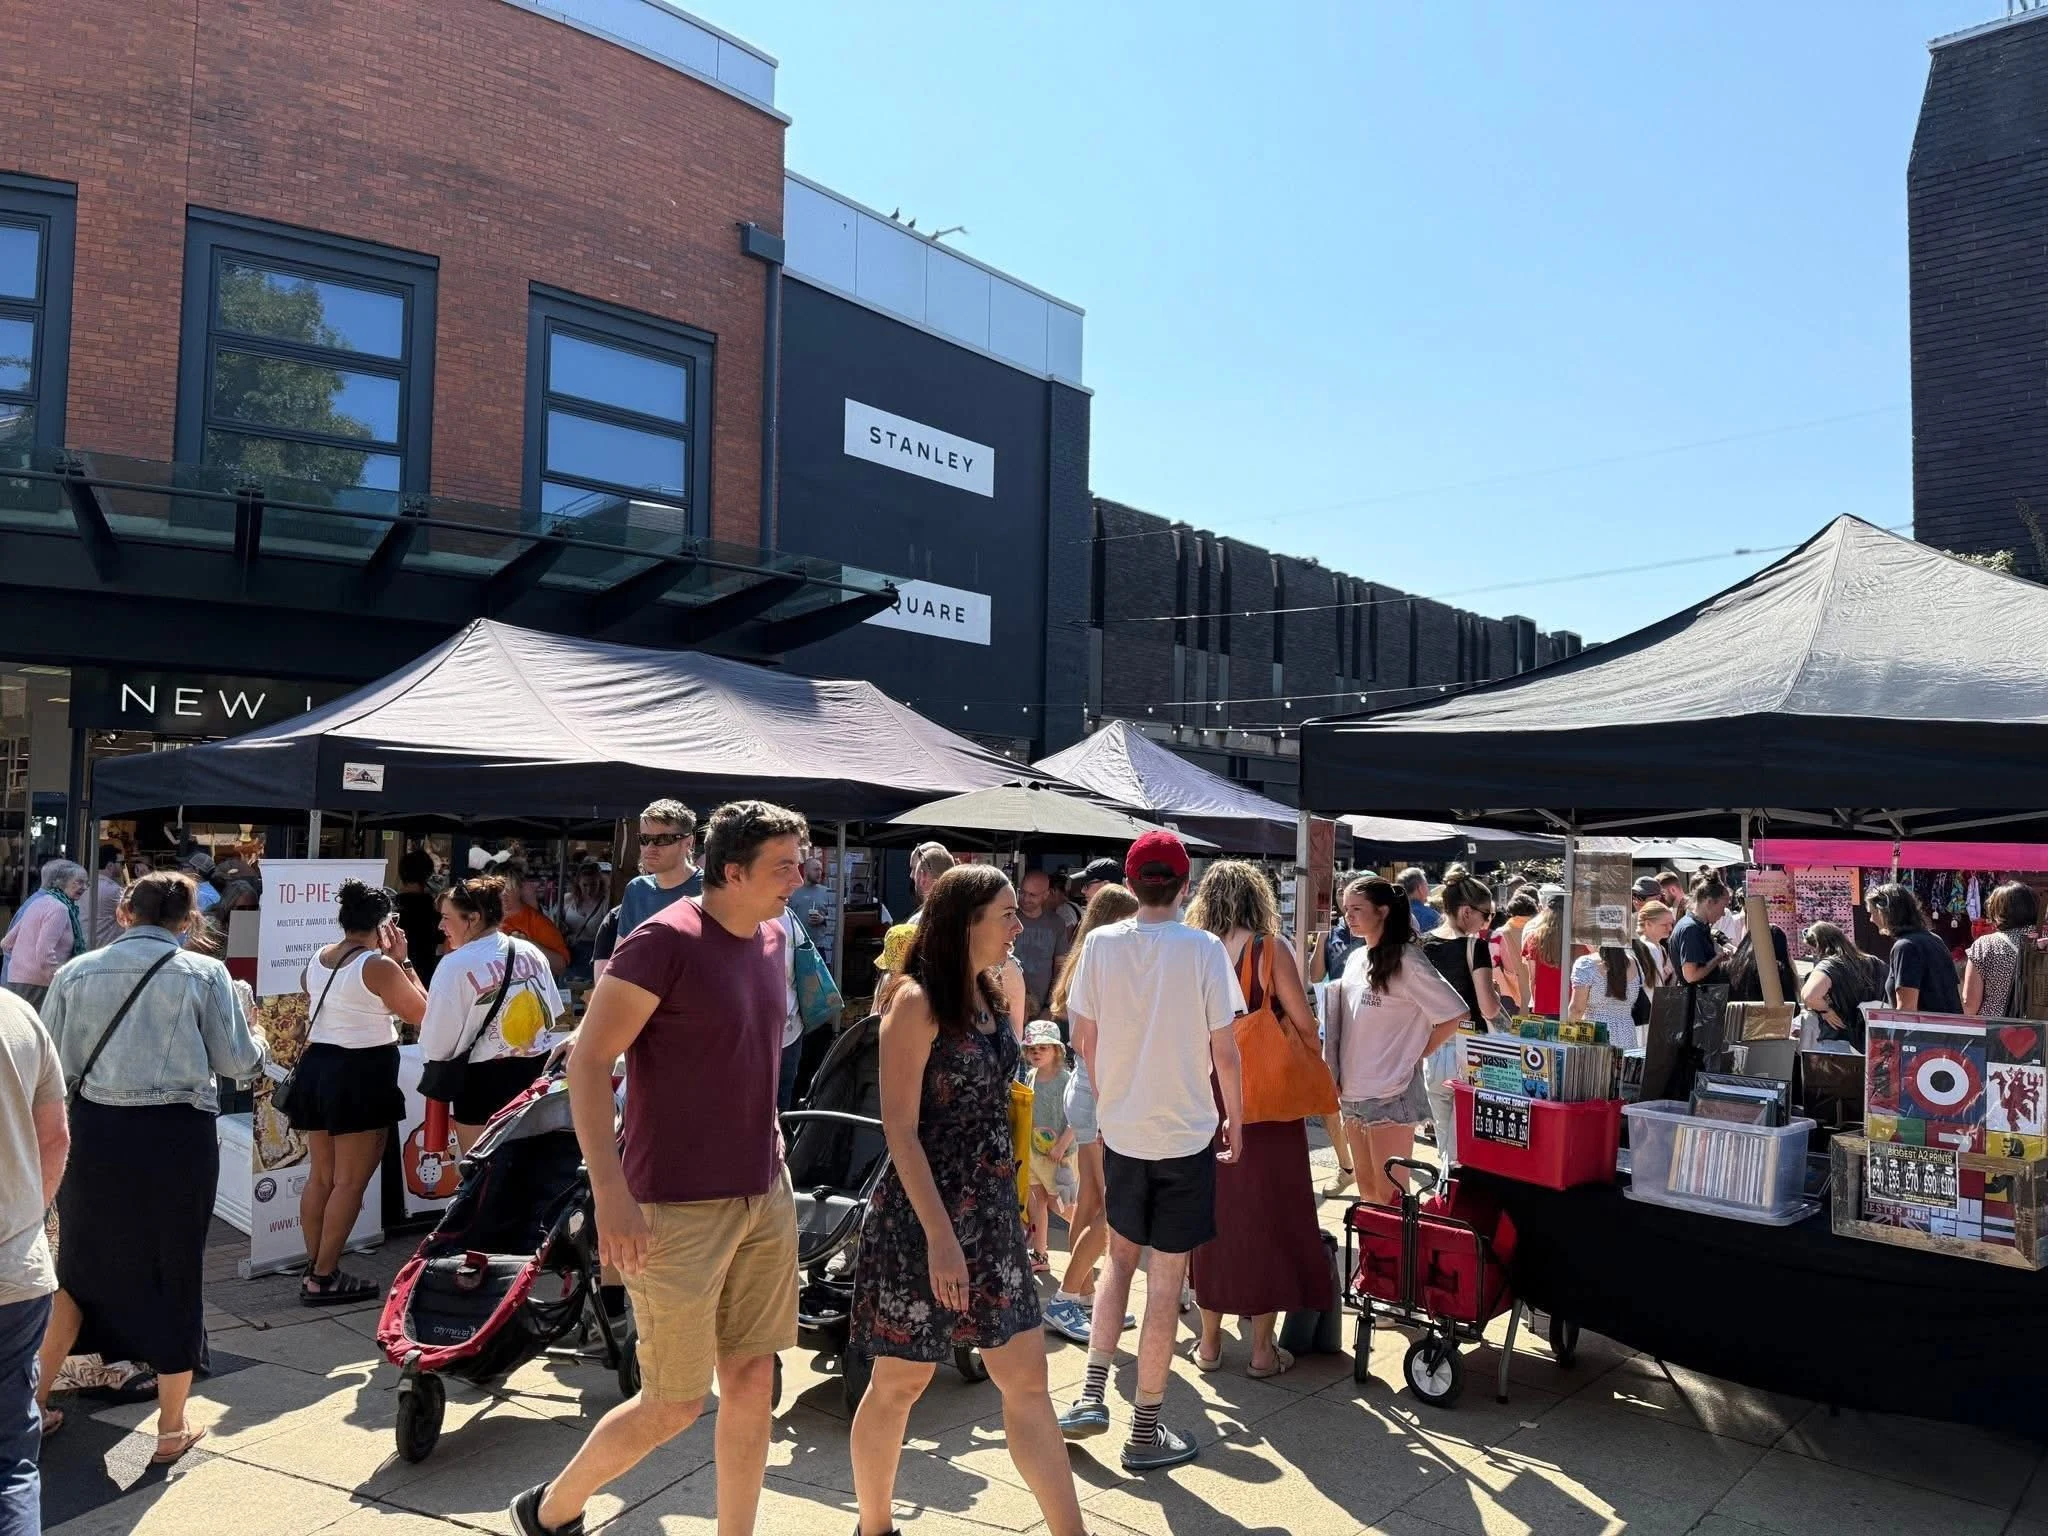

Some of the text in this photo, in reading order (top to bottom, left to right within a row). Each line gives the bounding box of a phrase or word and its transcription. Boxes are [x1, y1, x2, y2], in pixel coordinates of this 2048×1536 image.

[870, 426, 973, 473] STANLEY
[891, 596, 965, 623] QUARE
[121, 683, 266, 719] NEW
[279, 883, 337, 904] TO-PIE-
[277, 918, 304, 927] MULTIPLE
[305, 918, 327, 926] AWARD
[285, 944, 312, 953] WINNER
[1486, 1107, 1493, 1116] 2
[1498, 1110, 1504, 1118] 3
[1509, 1112, 1516, 1121] 4
[1521, 1114, 1528, 1123] 5
[1887, 1148, 1953, 1164] BIGGEST A2 PRINTS
[1889, 1159, 1898, 1168] 2
[1907, 1161, 1916, 1170] 3
[1925, 1163, 1935, 1173] 4
[1944, 1166, 1954, 1175] 5
[1872, 1167, 1955, 1196] £30 £55 £70 £90 £100
